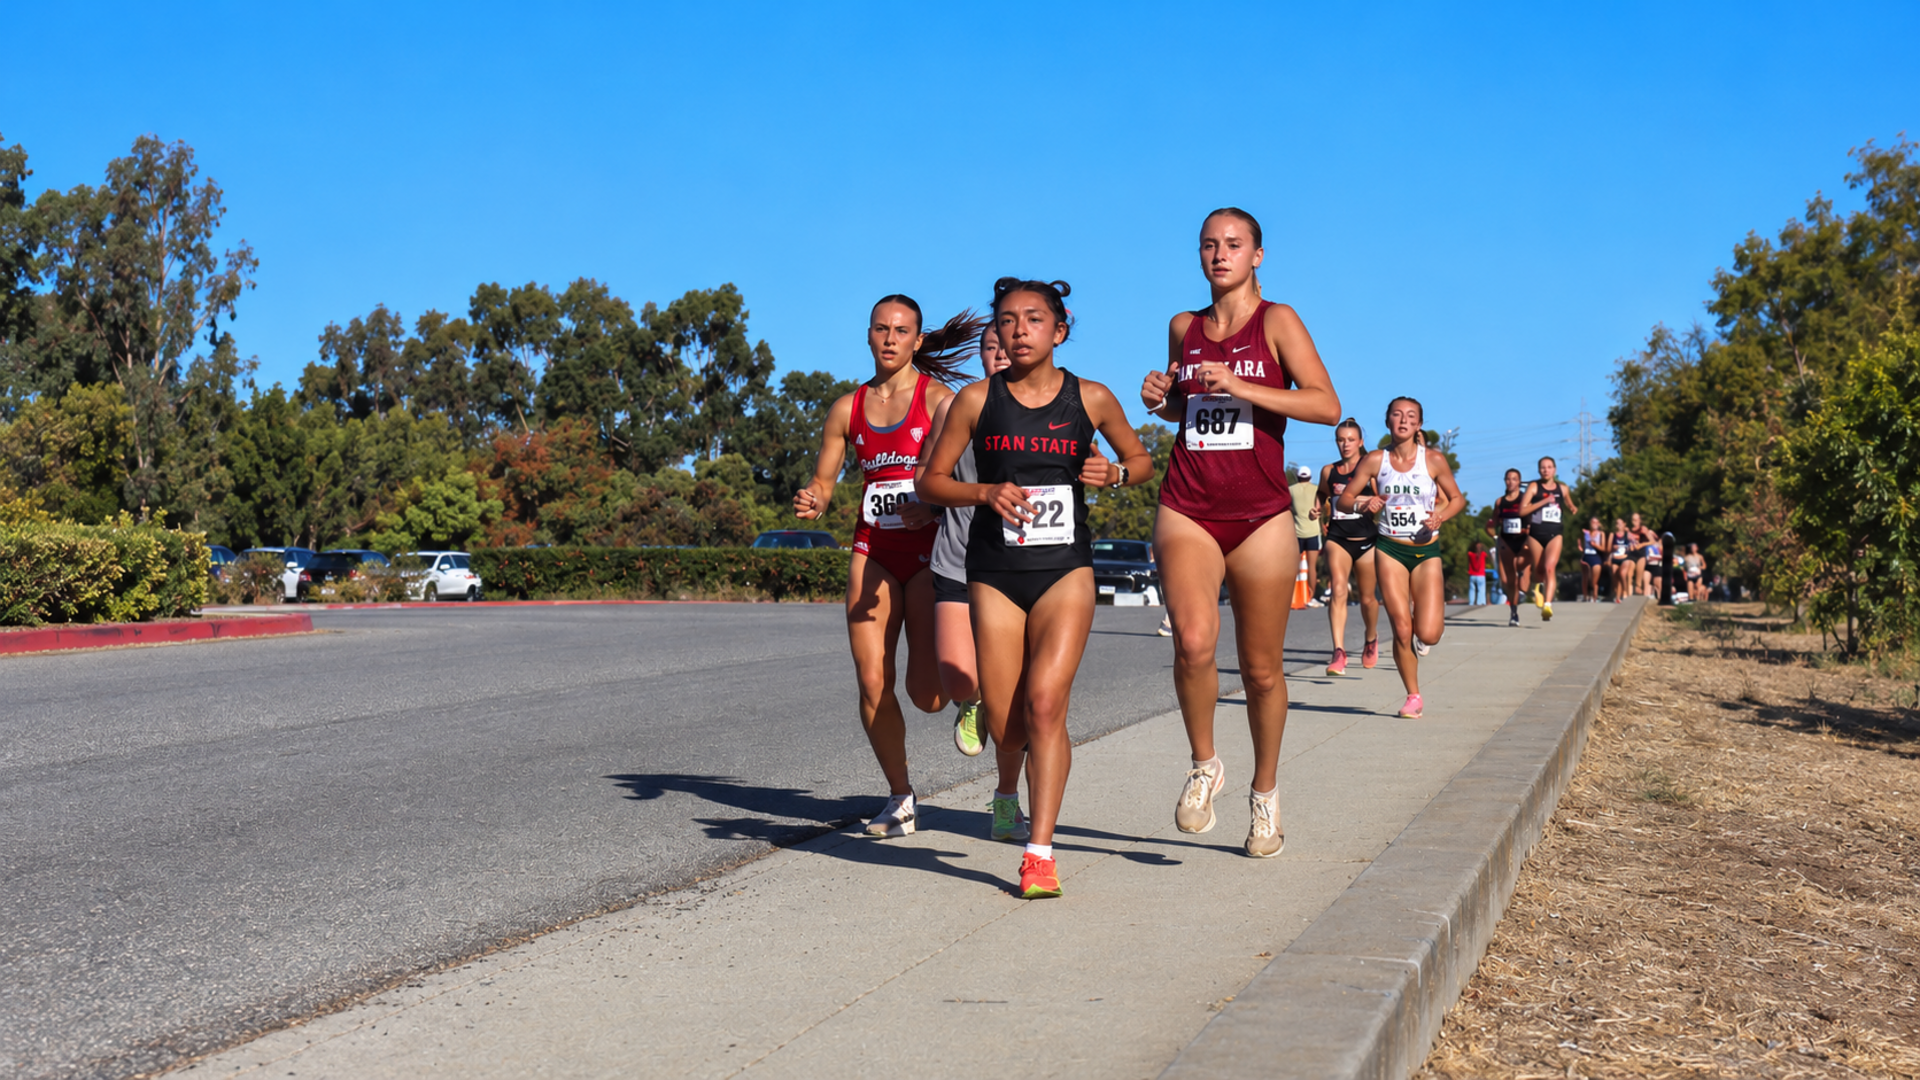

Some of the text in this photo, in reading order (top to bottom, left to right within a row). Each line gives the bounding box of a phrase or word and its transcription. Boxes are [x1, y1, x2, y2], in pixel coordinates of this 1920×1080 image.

[1196, 408, 1241, 435] 687
[985, 435, 1078, 456] STAN STATE
[861, 450, 918, 471] Bulldogs
[1018, 500, 1065, 528] 22
[1391, 511, 1417, 527] 554
